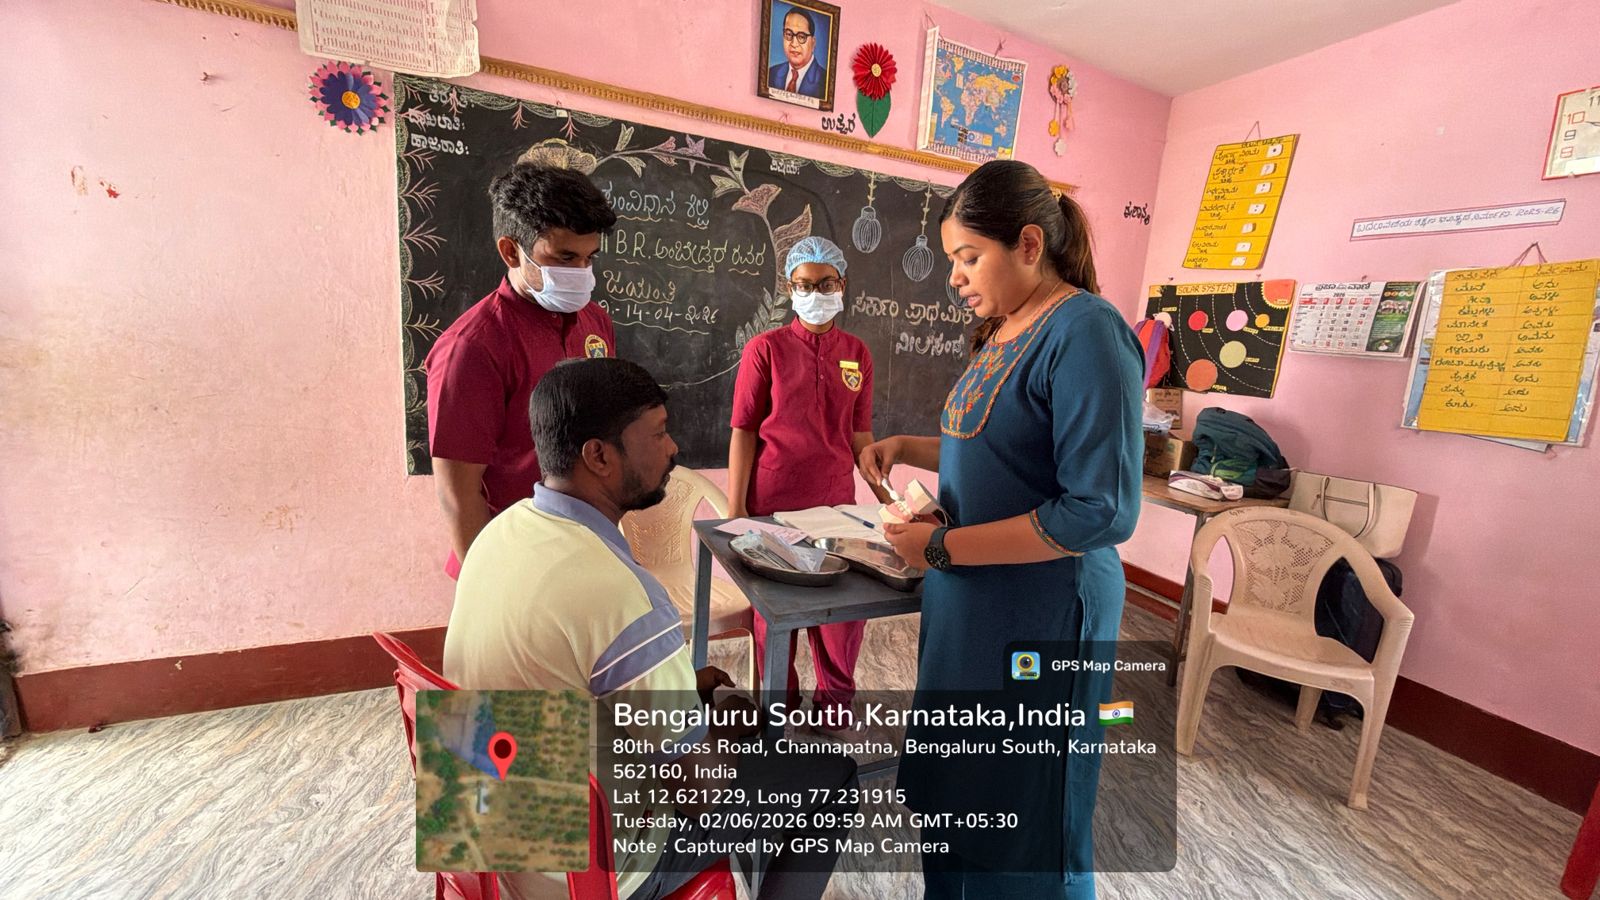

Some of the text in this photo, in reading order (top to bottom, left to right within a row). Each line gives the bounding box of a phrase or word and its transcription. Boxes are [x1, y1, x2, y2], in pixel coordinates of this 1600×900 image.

[1567, 111, 1585, 124] 10
[1564, 130, 1576, 141] 9
[1561, 146, 1573, 158] 8
[1178, 286, 1200, 295] SOLAR
